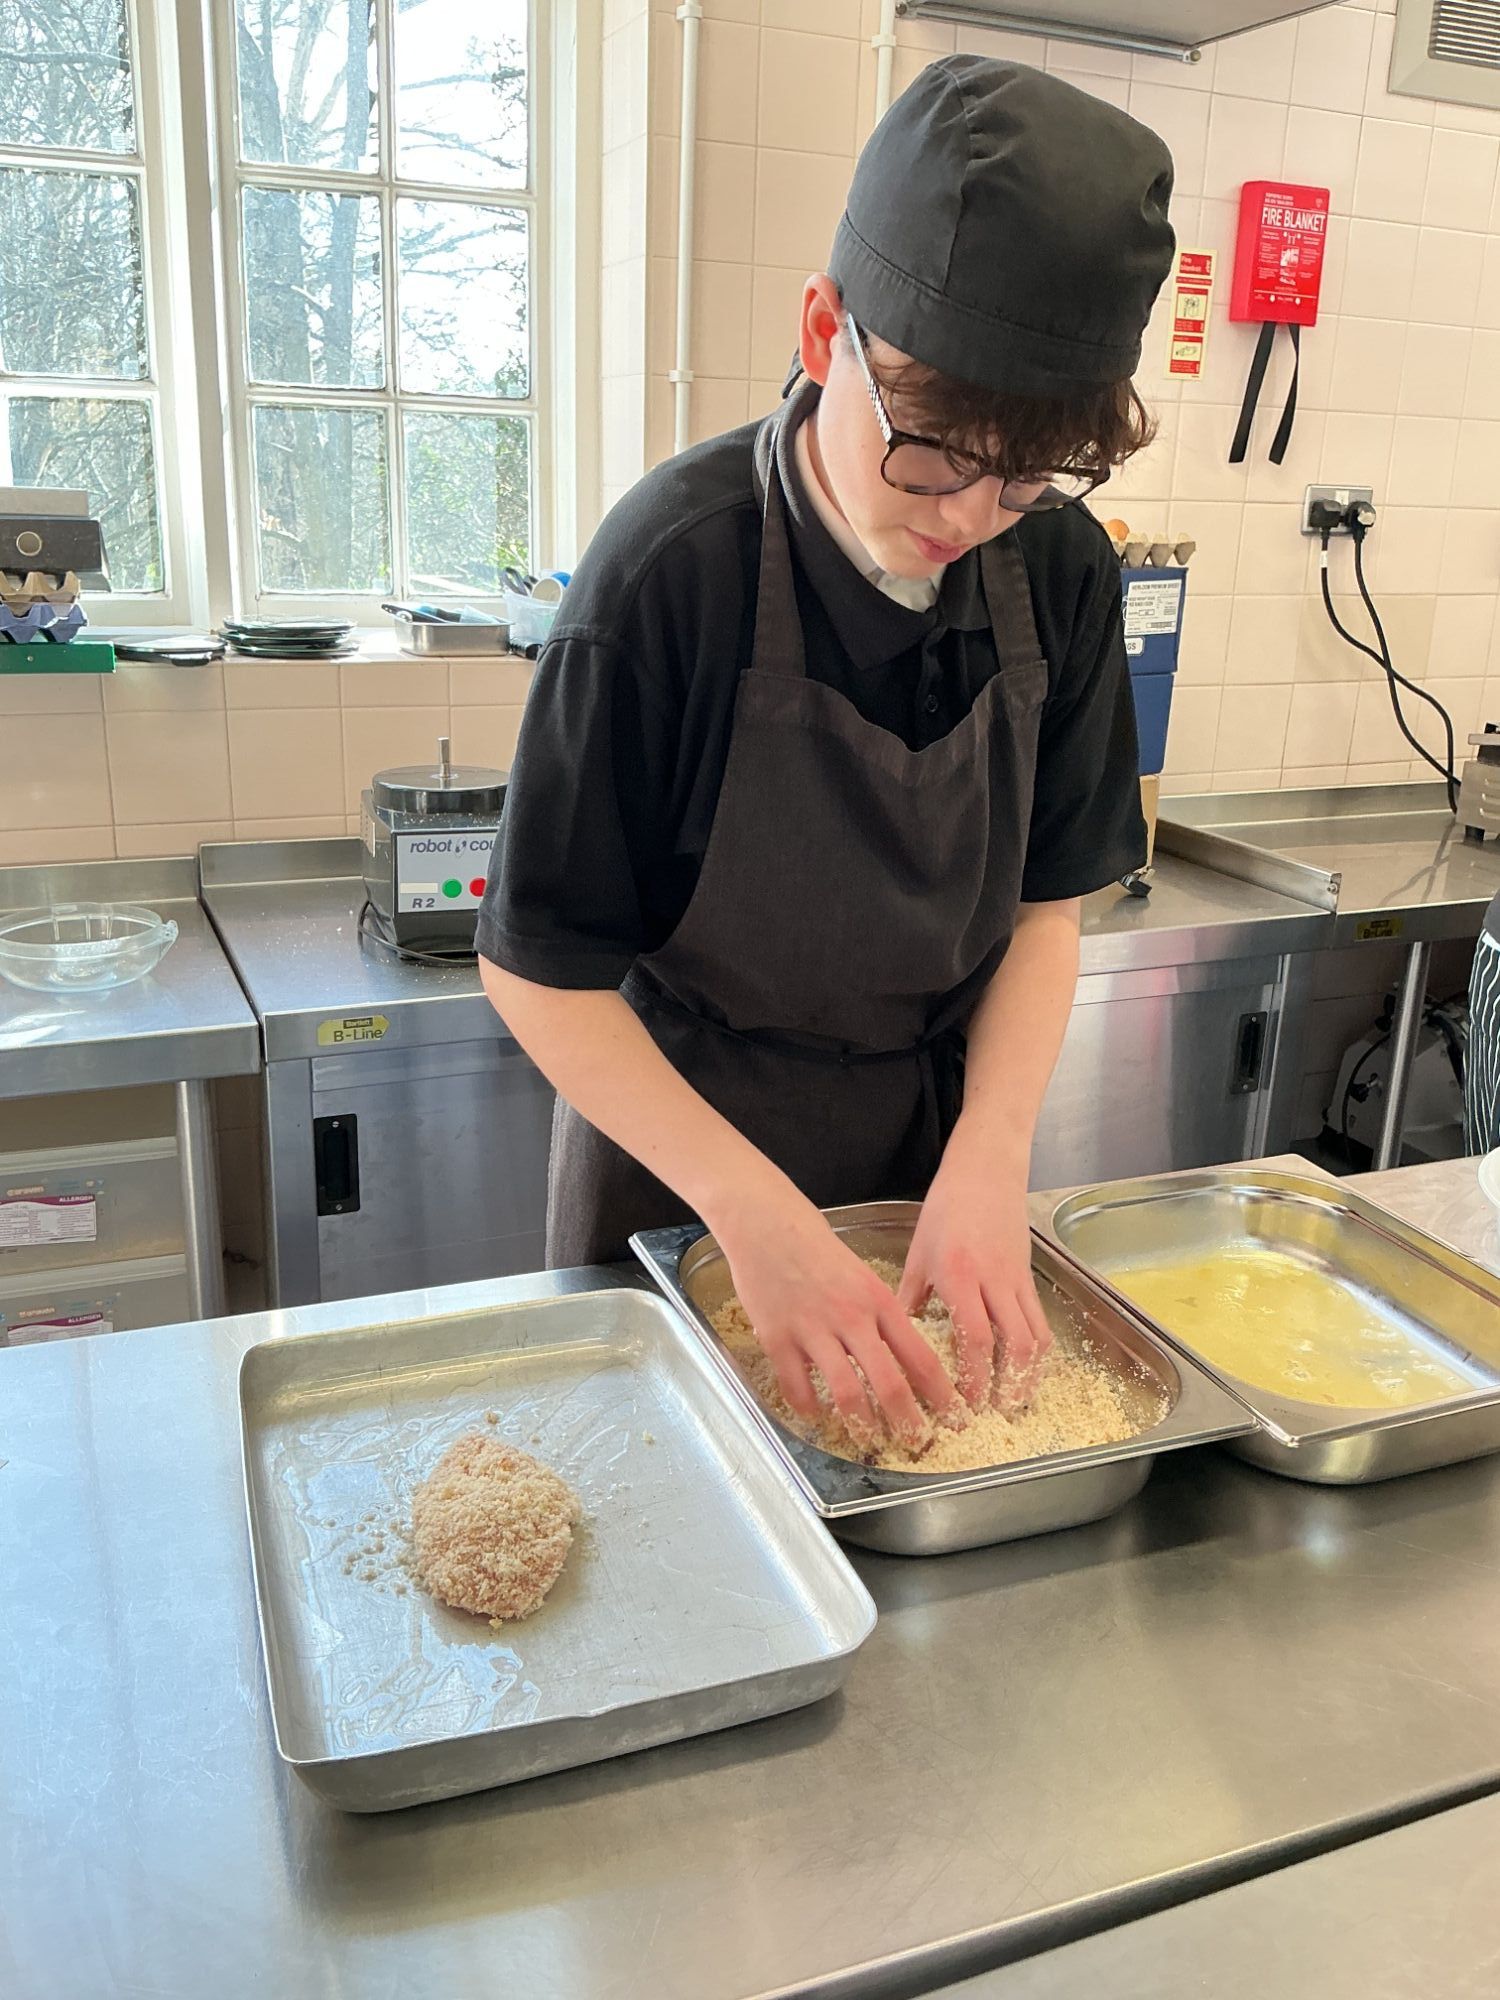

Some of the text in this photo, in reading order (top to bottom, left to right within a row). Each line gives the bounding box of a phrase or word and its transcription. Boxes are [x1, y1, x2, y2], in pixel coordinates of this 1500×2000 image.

[1262, 207, 1326, 232] FIRE BLANKET
[410, 839, 452, 853] robot
[412, 898, 435, 908] R 2
[333, 1028, 383, 1042] B-Line
